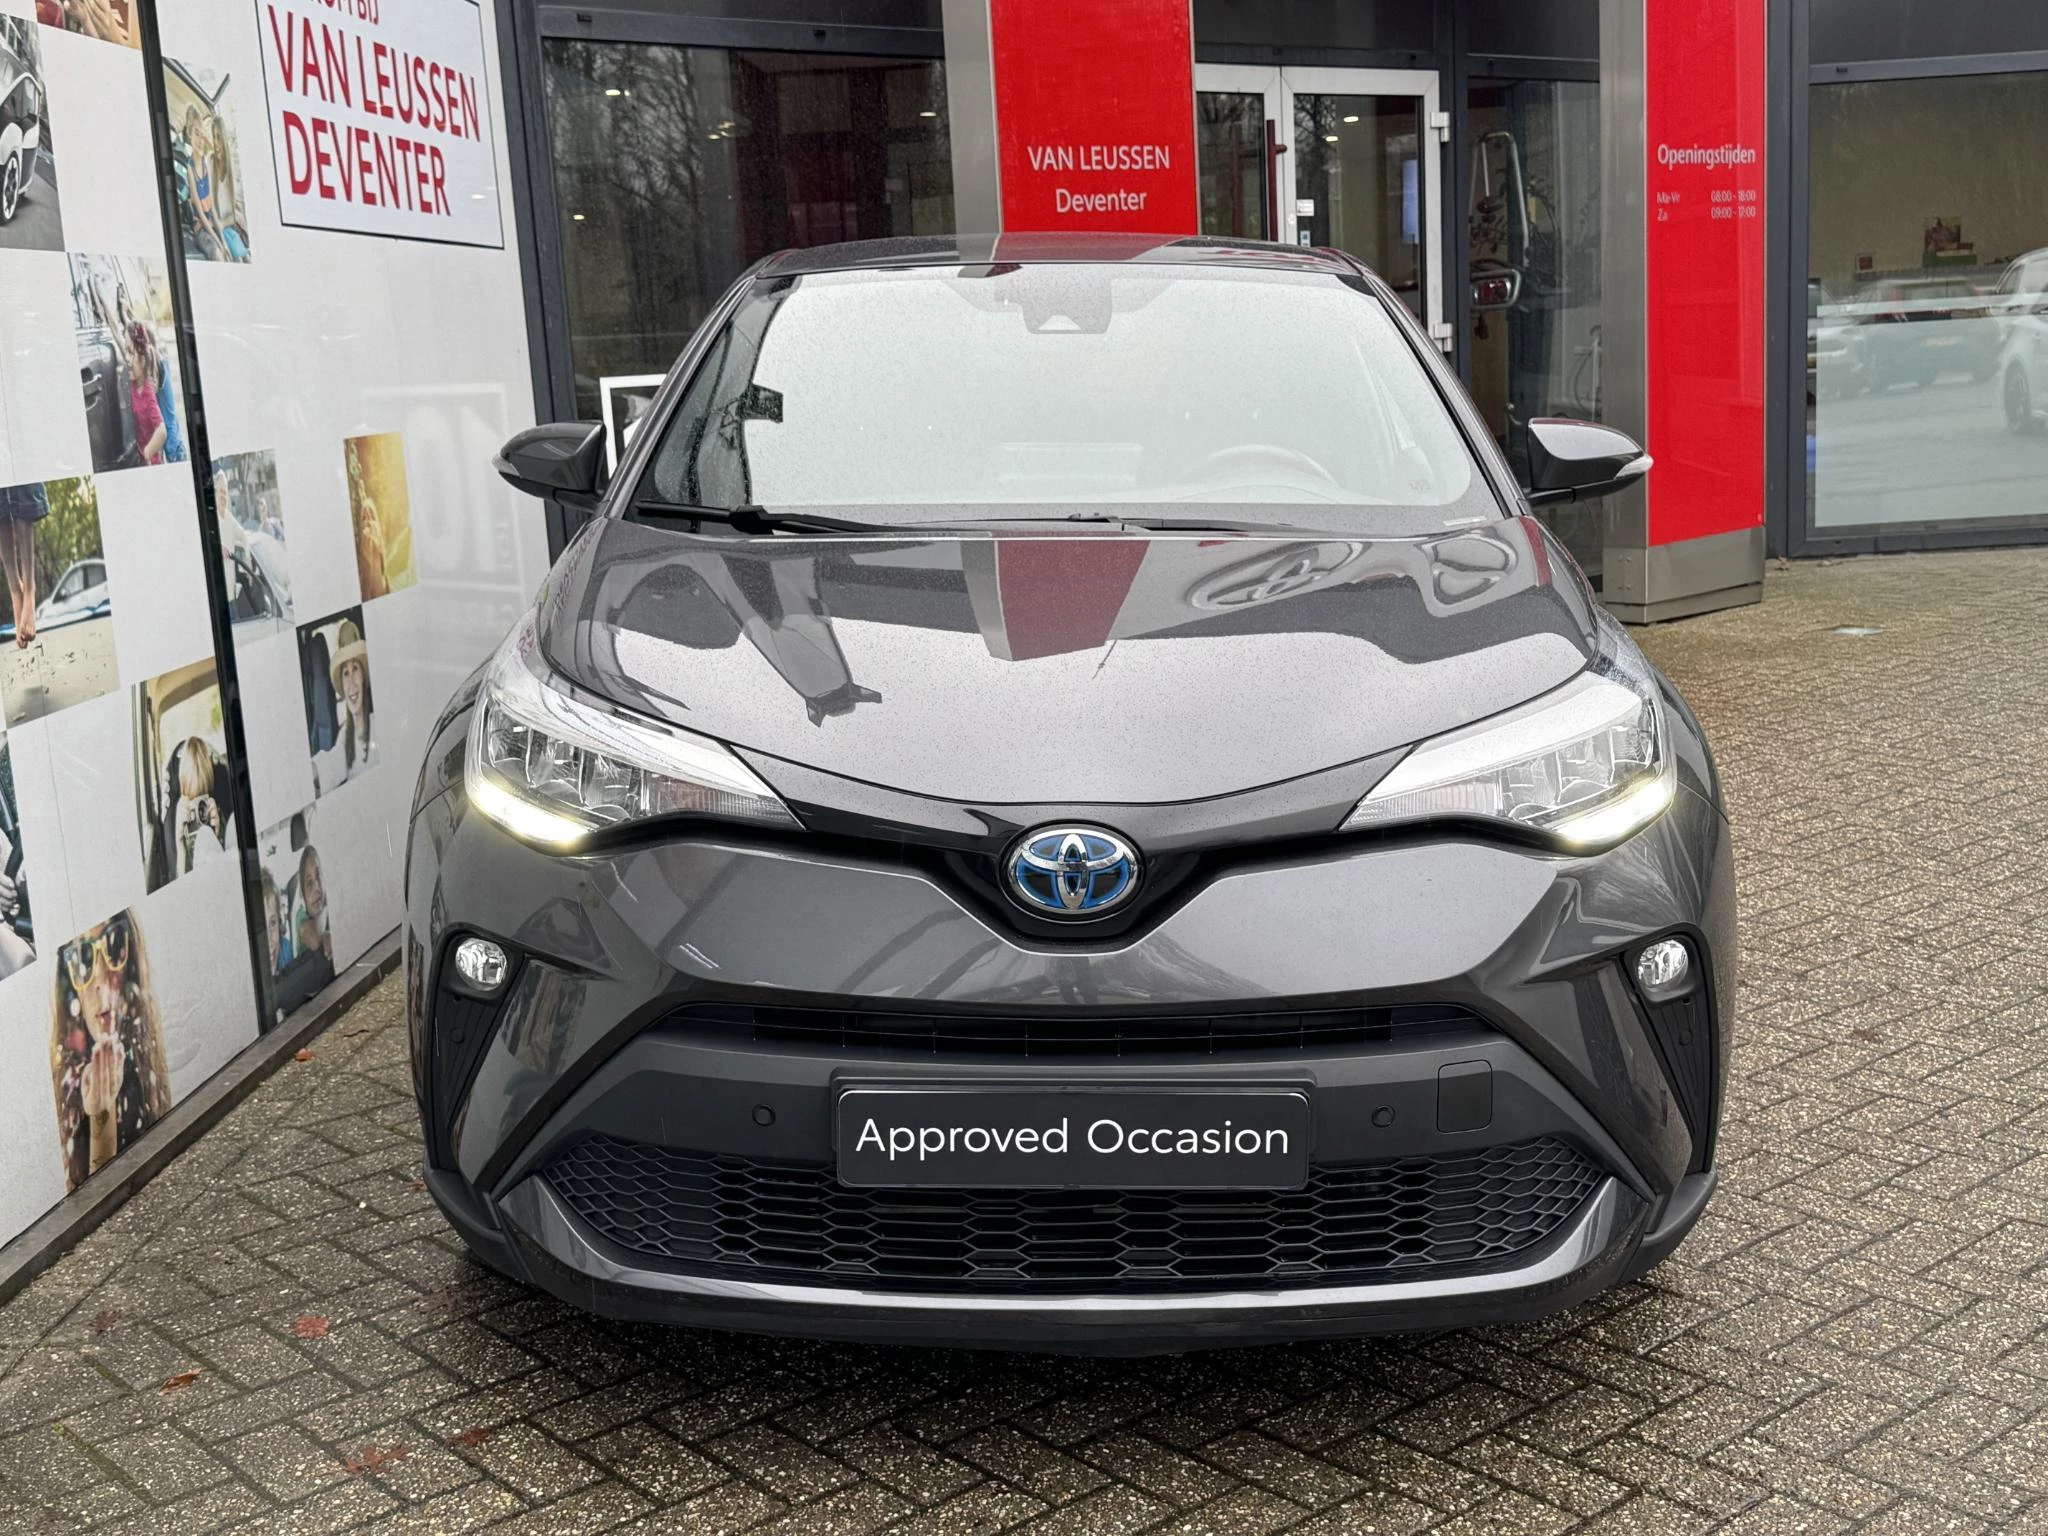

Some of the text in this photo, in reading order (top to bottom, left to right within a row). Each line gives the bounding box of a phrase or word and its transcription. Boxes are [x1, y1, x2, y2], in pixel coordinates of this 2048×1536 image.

[267, 4, 481, 143] VAN LEUSSEN
[282, 110, 451, 217] DEVENTER
[1027, 145, 1170, 171] VAN LEUSSEN
[1657, 144, 1756, 171] Openingstijden
[1055, 188, 1147, 213] Deventer
[855, 1117, 1289, 1161] Approved Occasion
